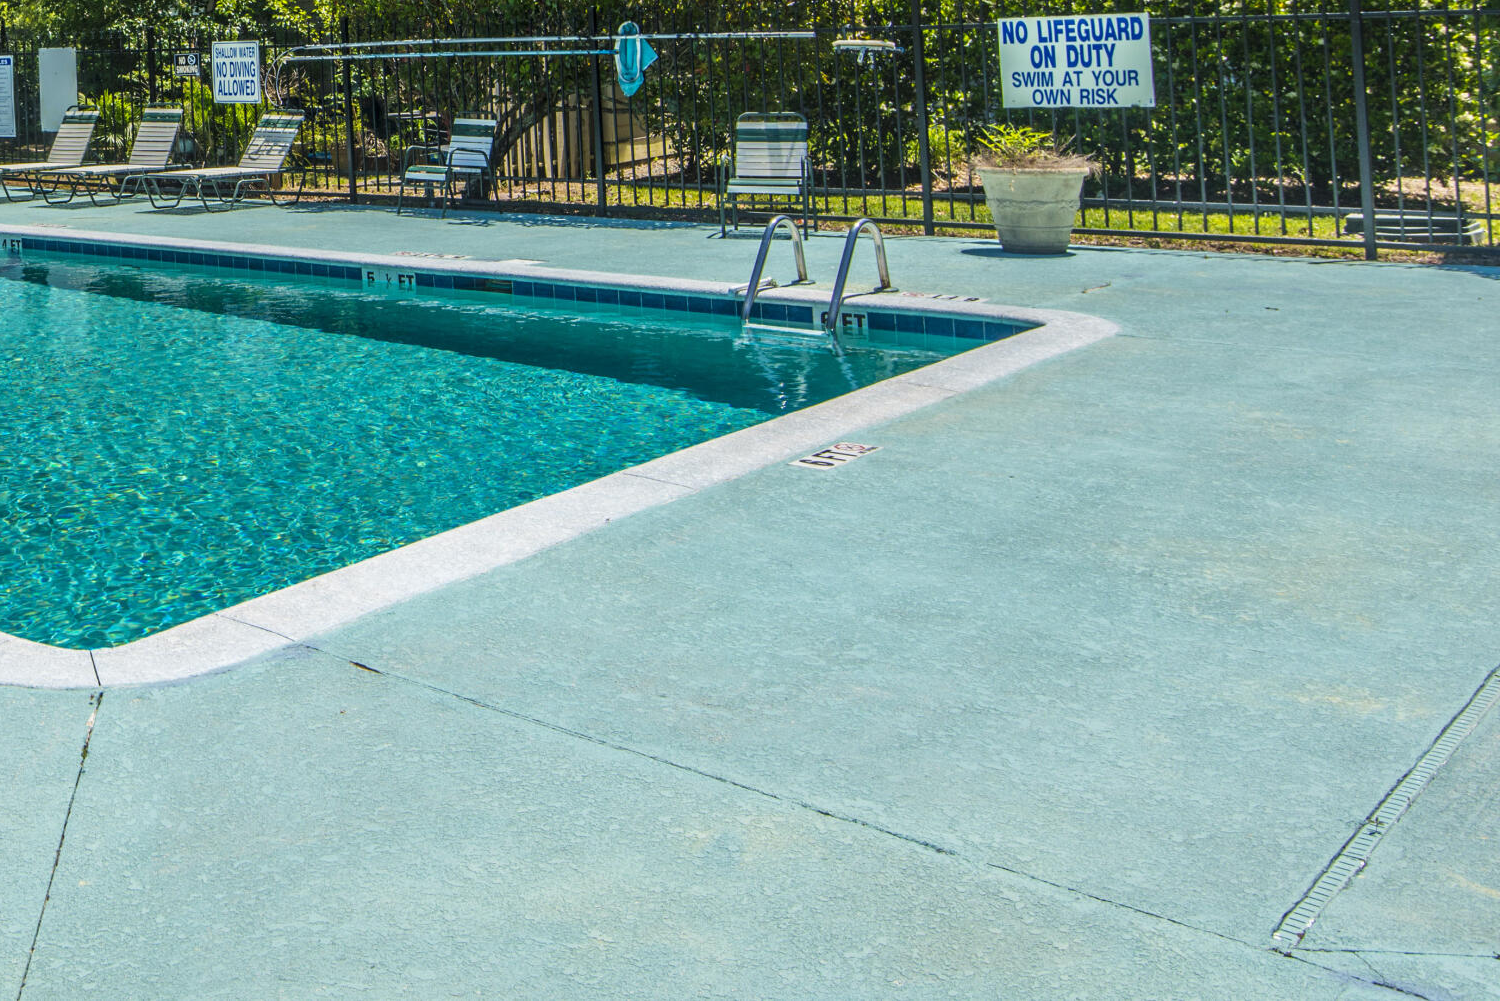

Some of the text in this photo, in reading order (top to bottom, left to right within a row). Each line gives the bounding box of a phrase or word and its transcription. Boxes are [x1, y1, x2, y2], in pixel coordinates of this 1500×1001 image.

[1002, 16, 1144, 45] NO LIFEGUARD
[178, 56, 186, 65] NO
[215, 46, 255, 59] SHALLOW WATER
[1030, 43, 1116, 69] ON DUTY
[176, 65, 198, 74] SMOKING
[216, 61, 256, 78] NO DIVING
[218, 79, 256, 96] ALLOWED
[1012, 70, 1139, 88] SWIM AT YOUR
[1032, 88, 1118, 105] OWN RISK
[398, 274, 414, 285] FT
[842, 312, 866, 328] FT
